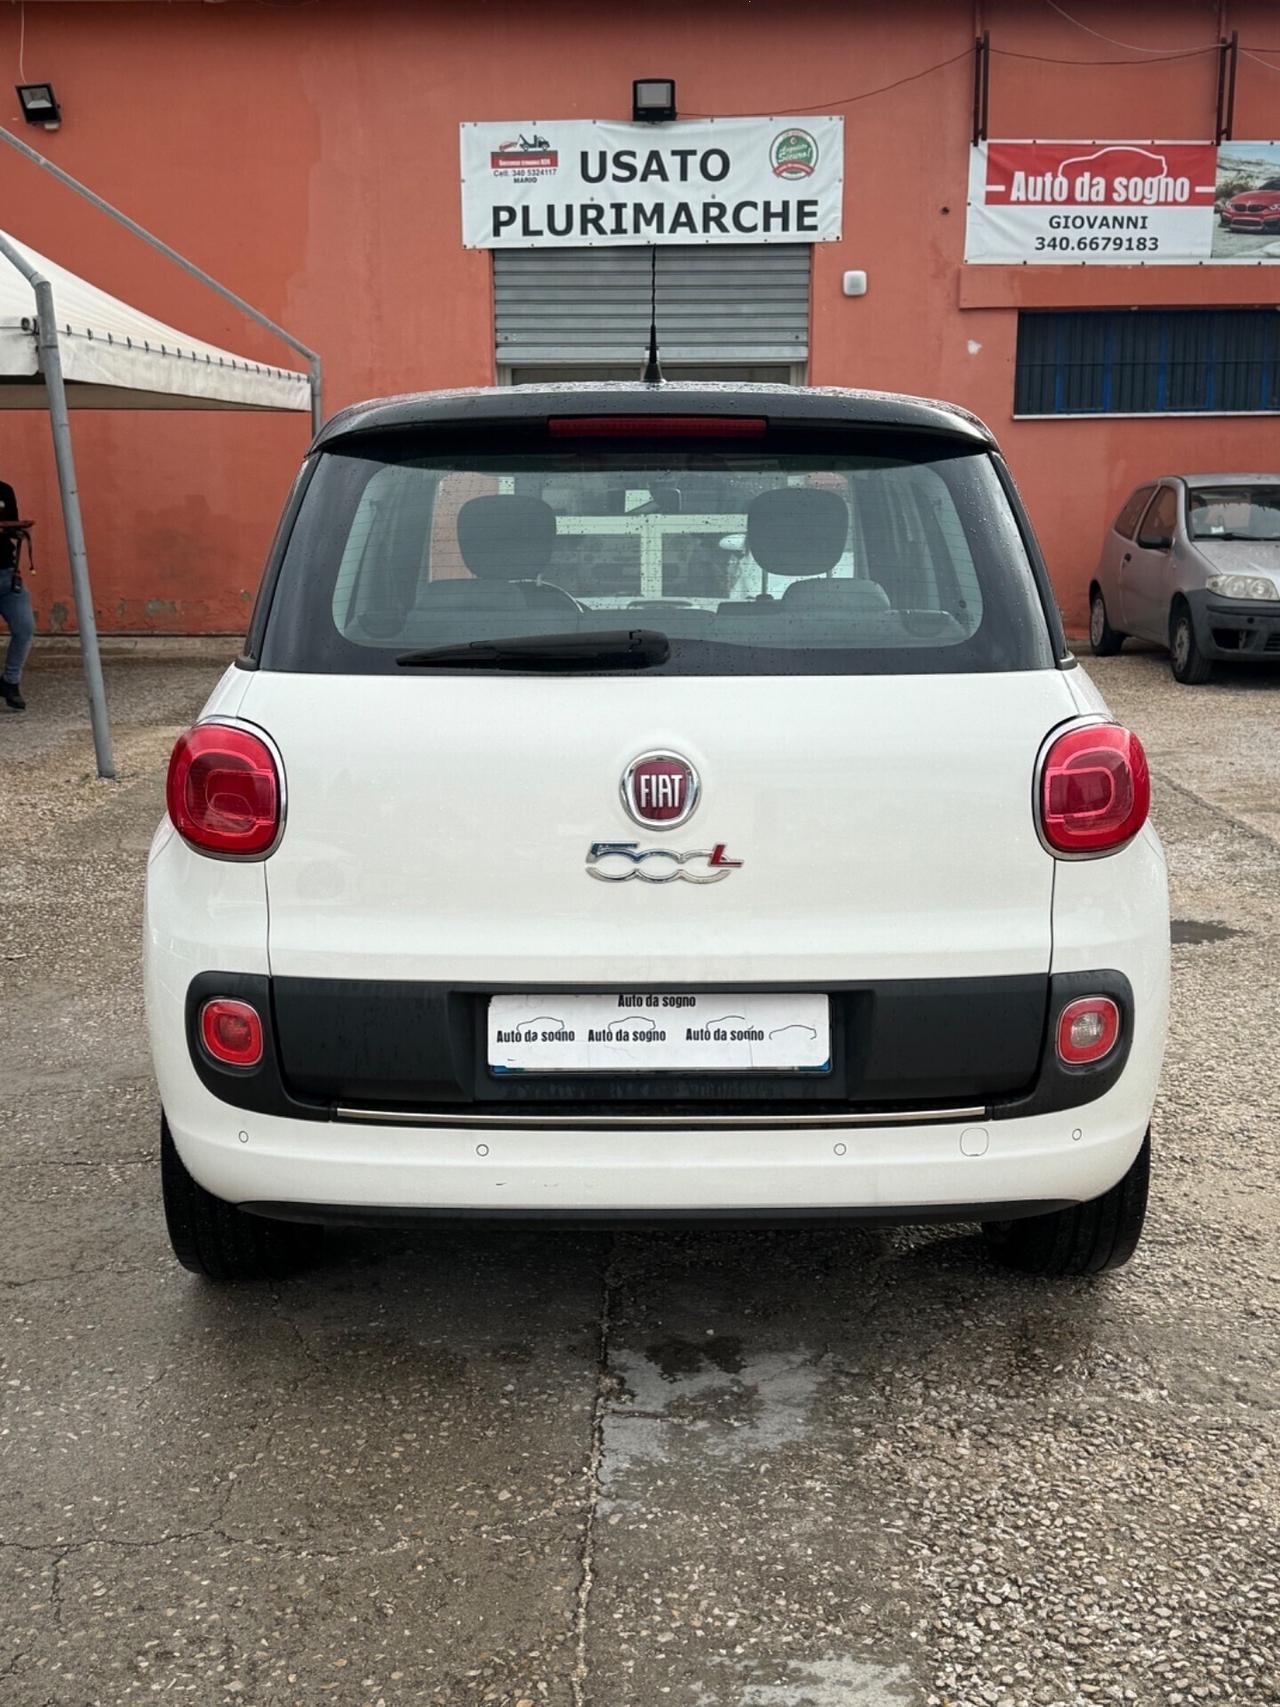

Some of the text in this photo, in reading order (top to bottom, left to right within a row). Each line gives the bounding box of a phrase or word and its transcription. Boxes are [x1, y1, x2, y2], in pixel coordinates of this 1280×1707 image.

[580, 148, 730, 183] USATO
[1010, 171, 1190, 205] Auto da sogno
[492, 199, 819, 237] PLURIMARCHE
[1049, 215, 1149, 230] GIOVANNI
[1035, 236, 1159, 251] 340.6679183
[640, 774, 683, 808] FIAT
[585, 841, 744, 884] 500L
[618, 994, 696, 1008] Auto da sogno
[496, 1030, 522, 1043] Auto
[524, 1030, 538, 1043] da
[588, 1029, 666, 1043] Auto da sogno
[686, 1028, 711, 1041] Auto
[713, 1028, 727, 1041] da
